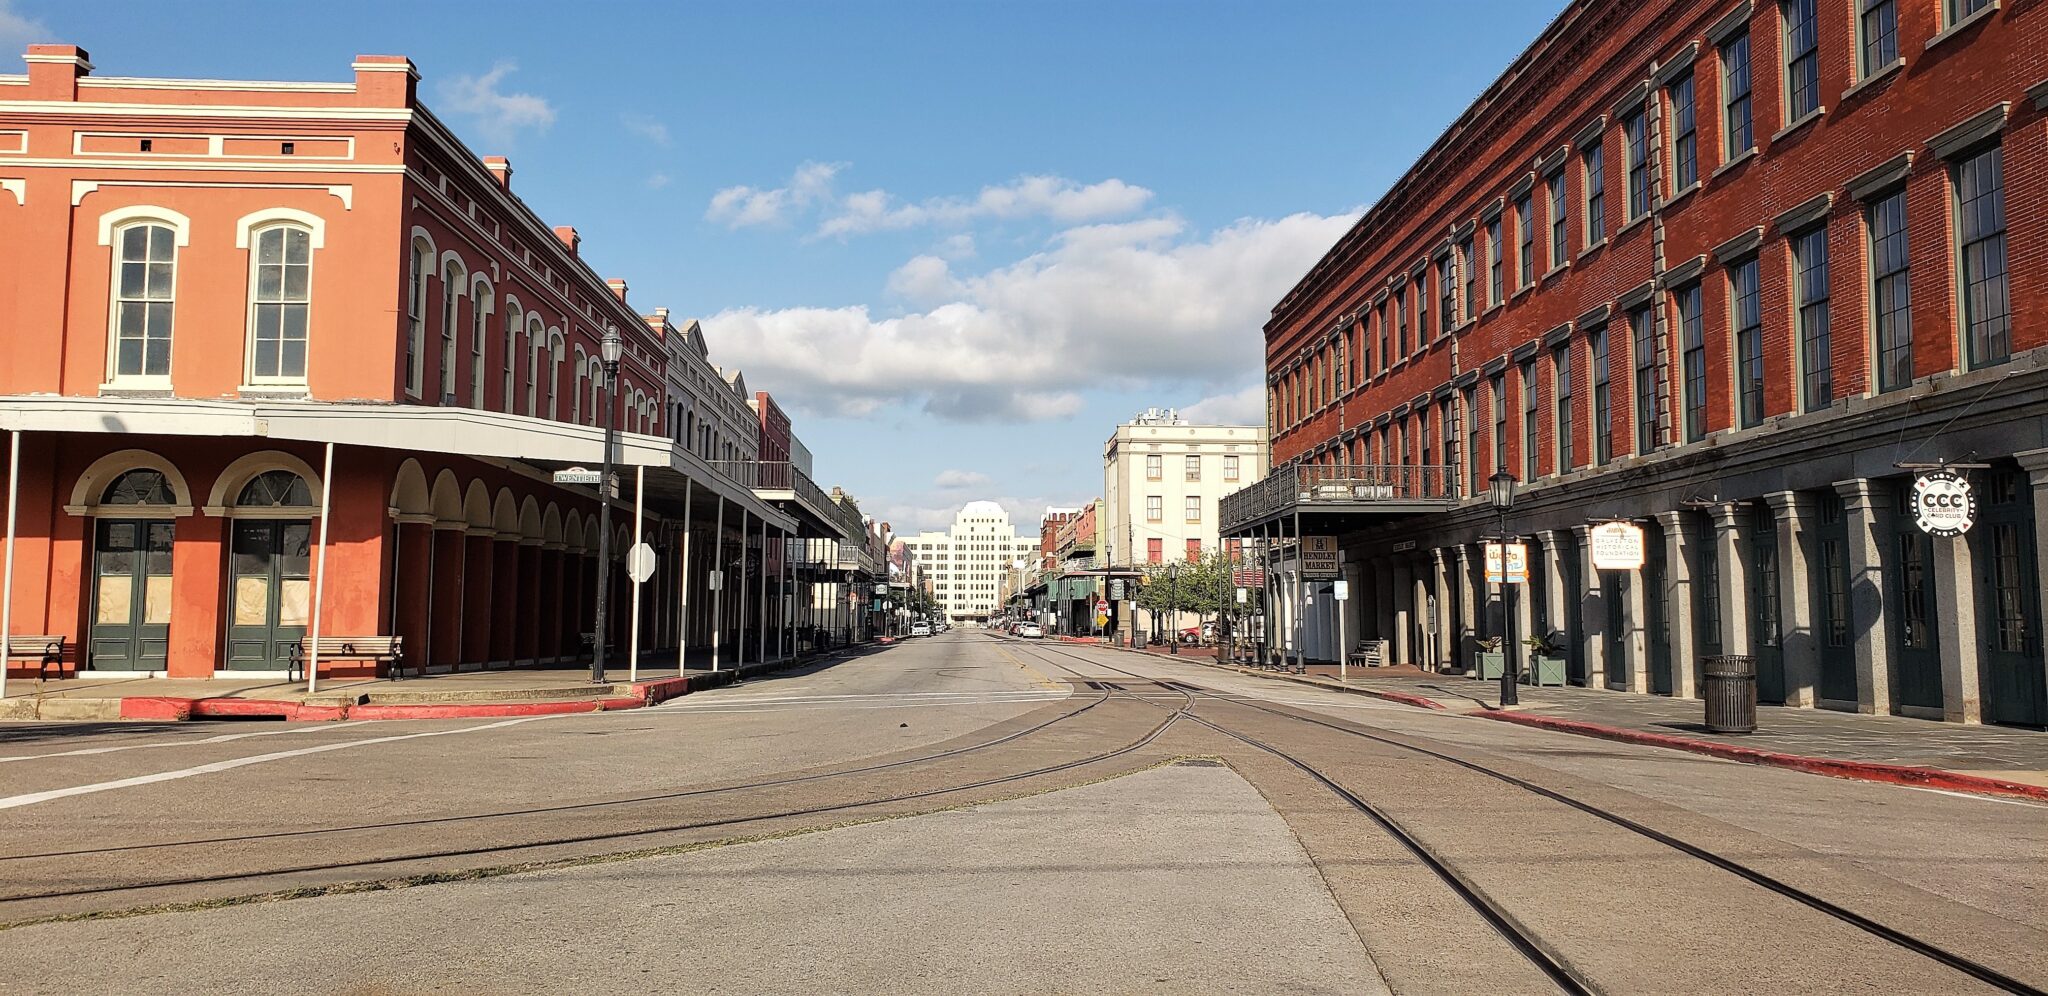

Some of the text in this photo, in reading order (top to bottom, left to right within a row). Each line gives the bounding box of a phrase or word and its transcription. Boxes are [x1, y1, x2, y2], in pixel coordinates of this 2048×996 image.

[556, 474, 599, 482] TWENTIETH
[1923, 493, 1963, 508] CCC
[1303, 551, 1336, 560] HENDLEY
[1305, 561, 1336, 569] MARKET
